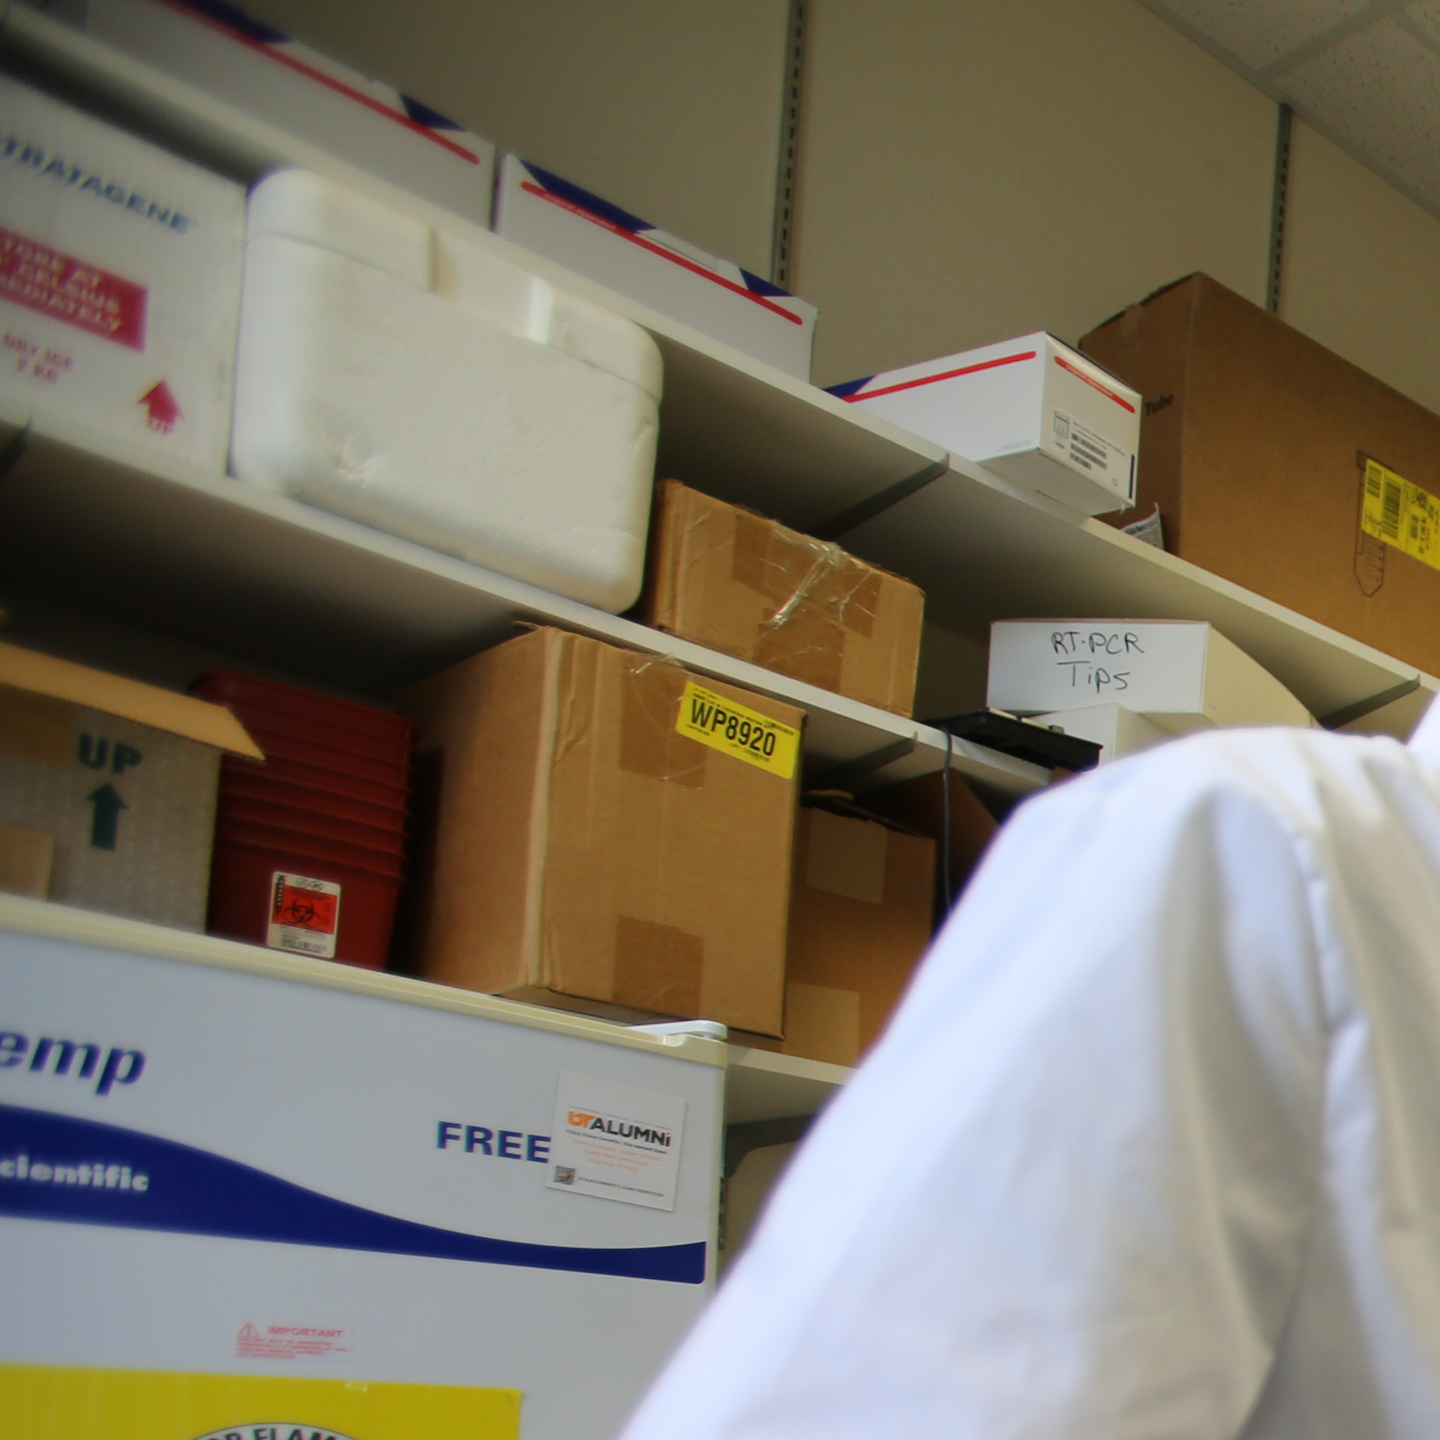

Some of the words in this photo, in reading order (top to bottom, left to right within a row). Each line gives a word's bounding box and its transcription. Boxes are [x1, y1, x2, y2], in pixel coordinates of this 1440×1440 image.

[1051, 631, 1146, 655] RT-PCR
[1056, 661, 1131, 693] Tips
[691, 698, 776, 757] WP8920
[76, 731, 143, 776] UP
[268, 1326, 343, 1337] IMPORTANT
